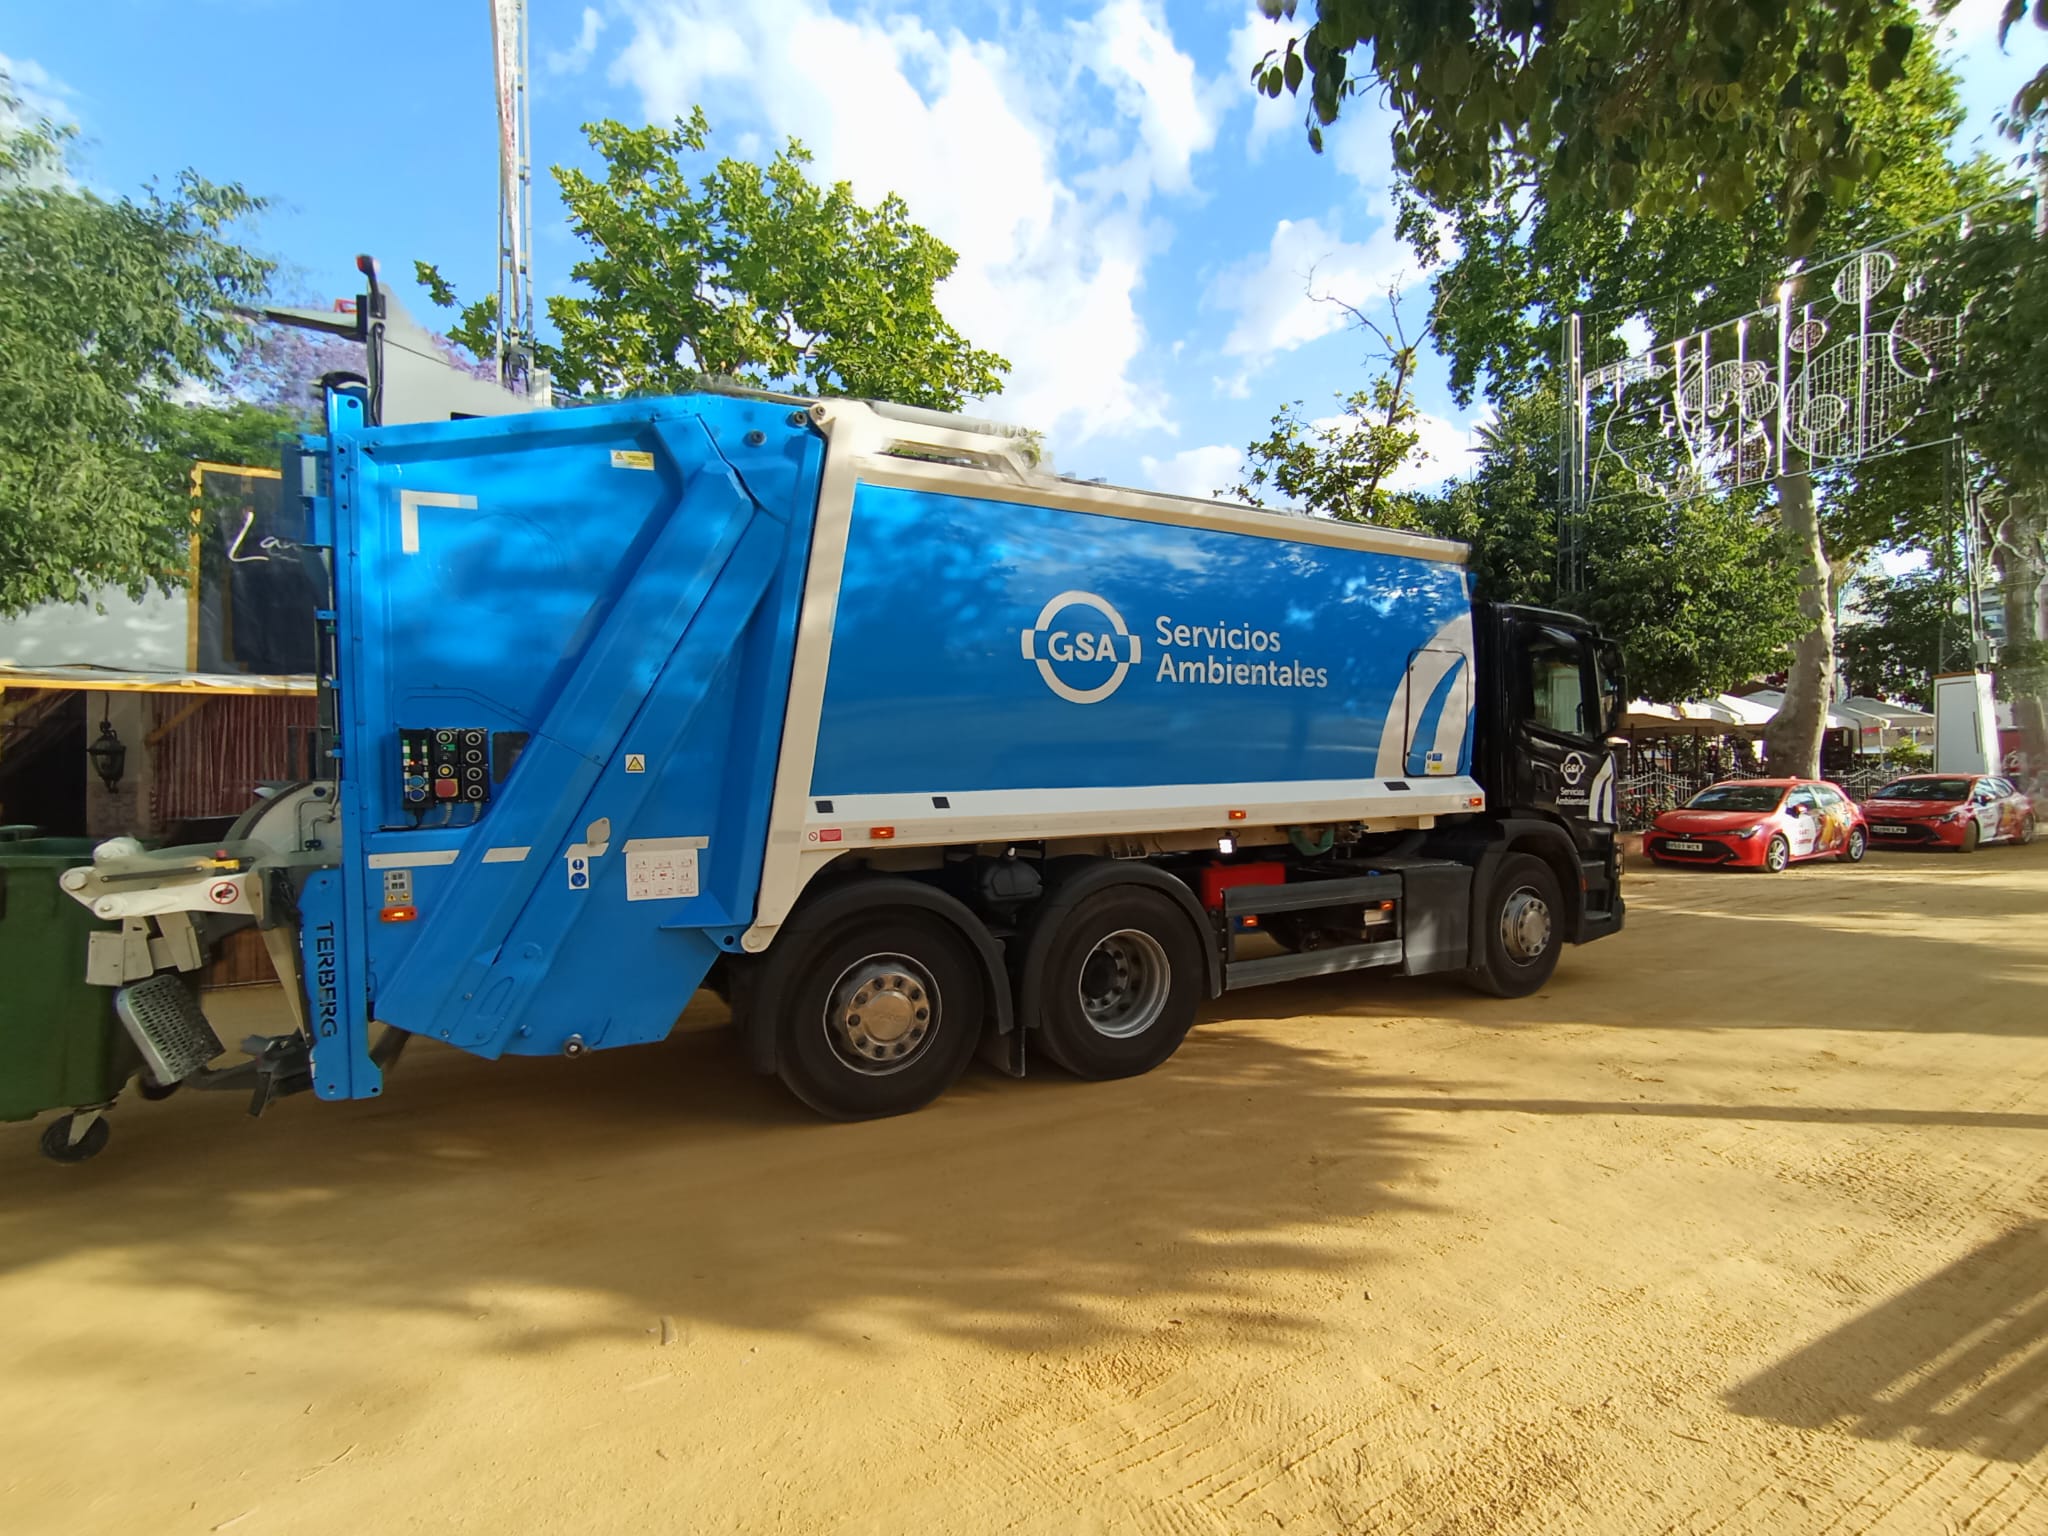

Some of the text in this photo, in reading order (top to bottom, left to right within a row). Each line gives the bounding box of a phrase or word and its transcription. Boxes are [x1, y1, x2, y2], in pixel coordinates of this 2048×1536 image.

[1048, 631, 1118, 662] GSA
[1156, 615, 1281, 652] Servicios
[1155, 653, 1328, 689] Ambientales
[1564, 763, 1580, 773] GSA
[1560, 786, 1585, 796] Servicios
[315, 919, 338, 1038] TERBERG
